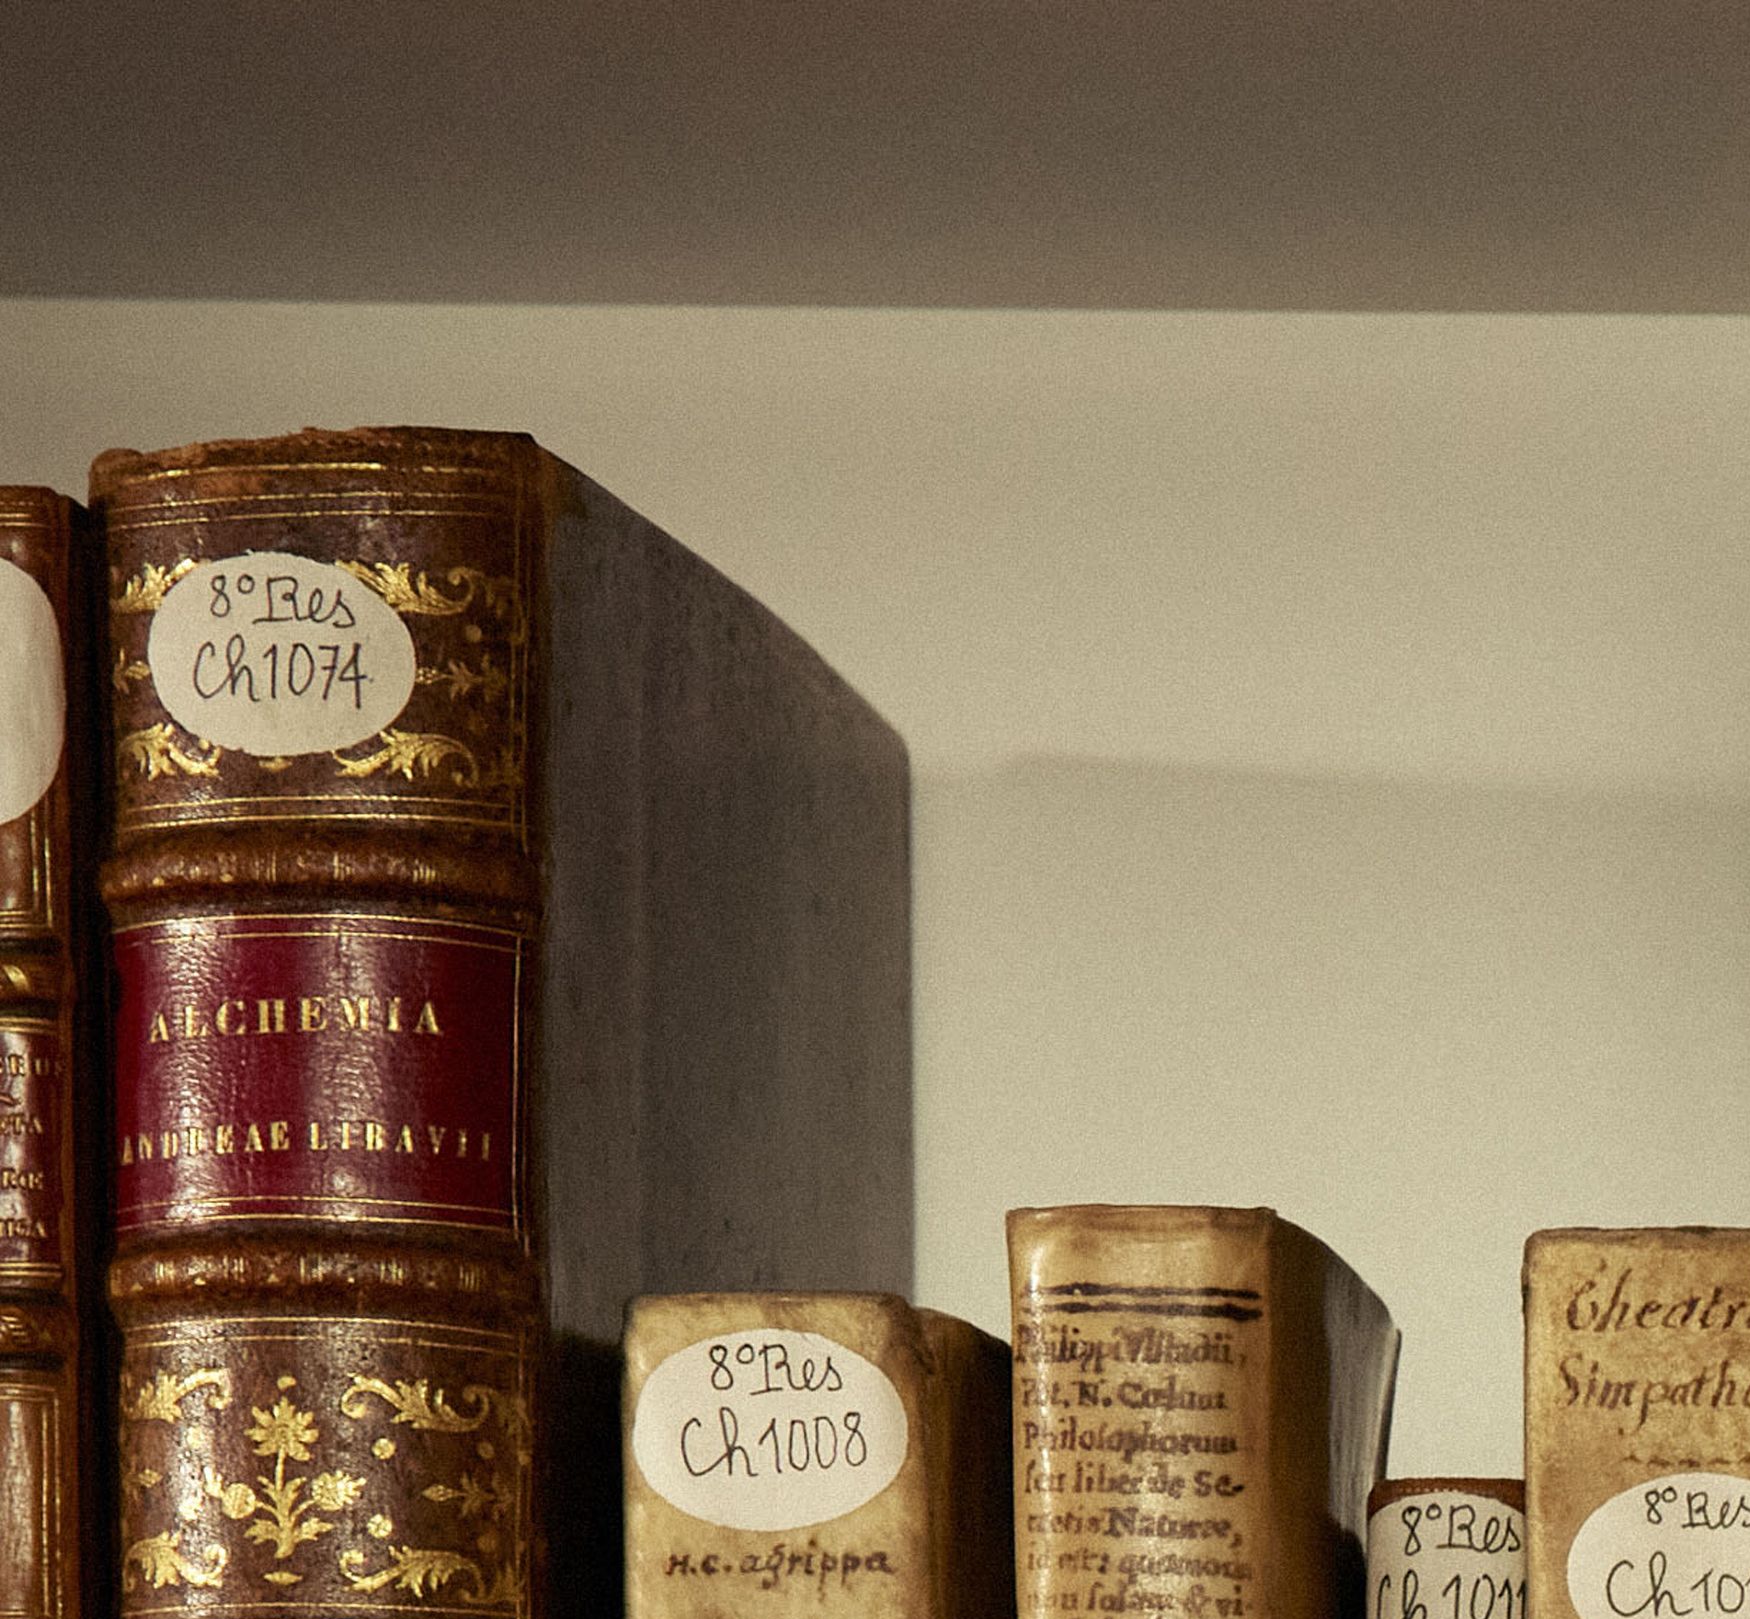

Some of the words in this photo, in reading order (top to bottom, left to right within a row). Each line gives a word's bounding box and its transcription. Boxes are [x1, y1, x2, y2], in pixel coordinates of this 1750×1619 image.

[149, 996, 445, 1044] ALCHEMIA
[120, 1121, 291, 1166] ANDREAE
[309, 1121, 491, 1161] LIBAVII
